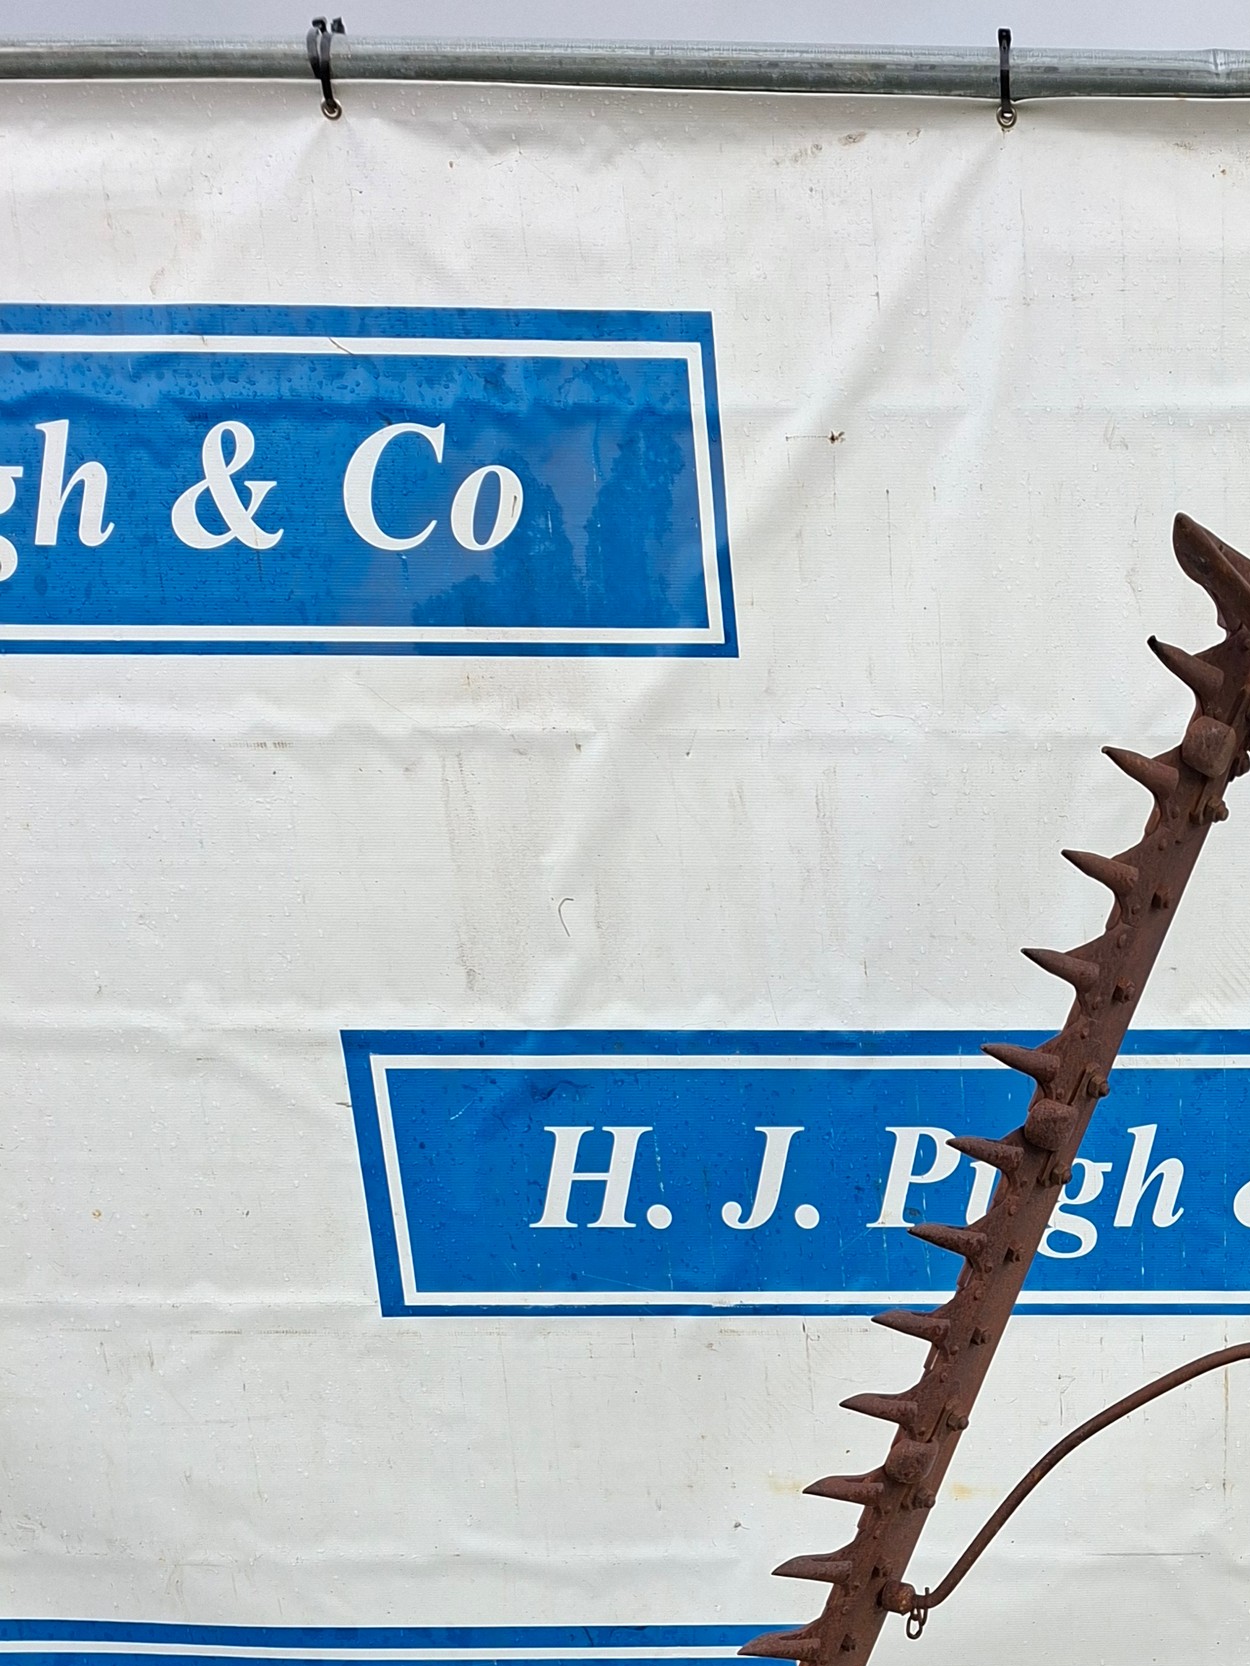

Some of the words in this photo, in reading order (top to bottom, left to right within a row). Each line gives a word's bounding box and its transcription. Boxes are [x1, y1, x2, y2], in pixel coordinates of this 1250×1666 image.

[171, 420, 284, 550] &
[342, 422, 524, 552] Co
[530, 1126, 672, 1230] H.
[721, 1126, 820, 1230] J.
